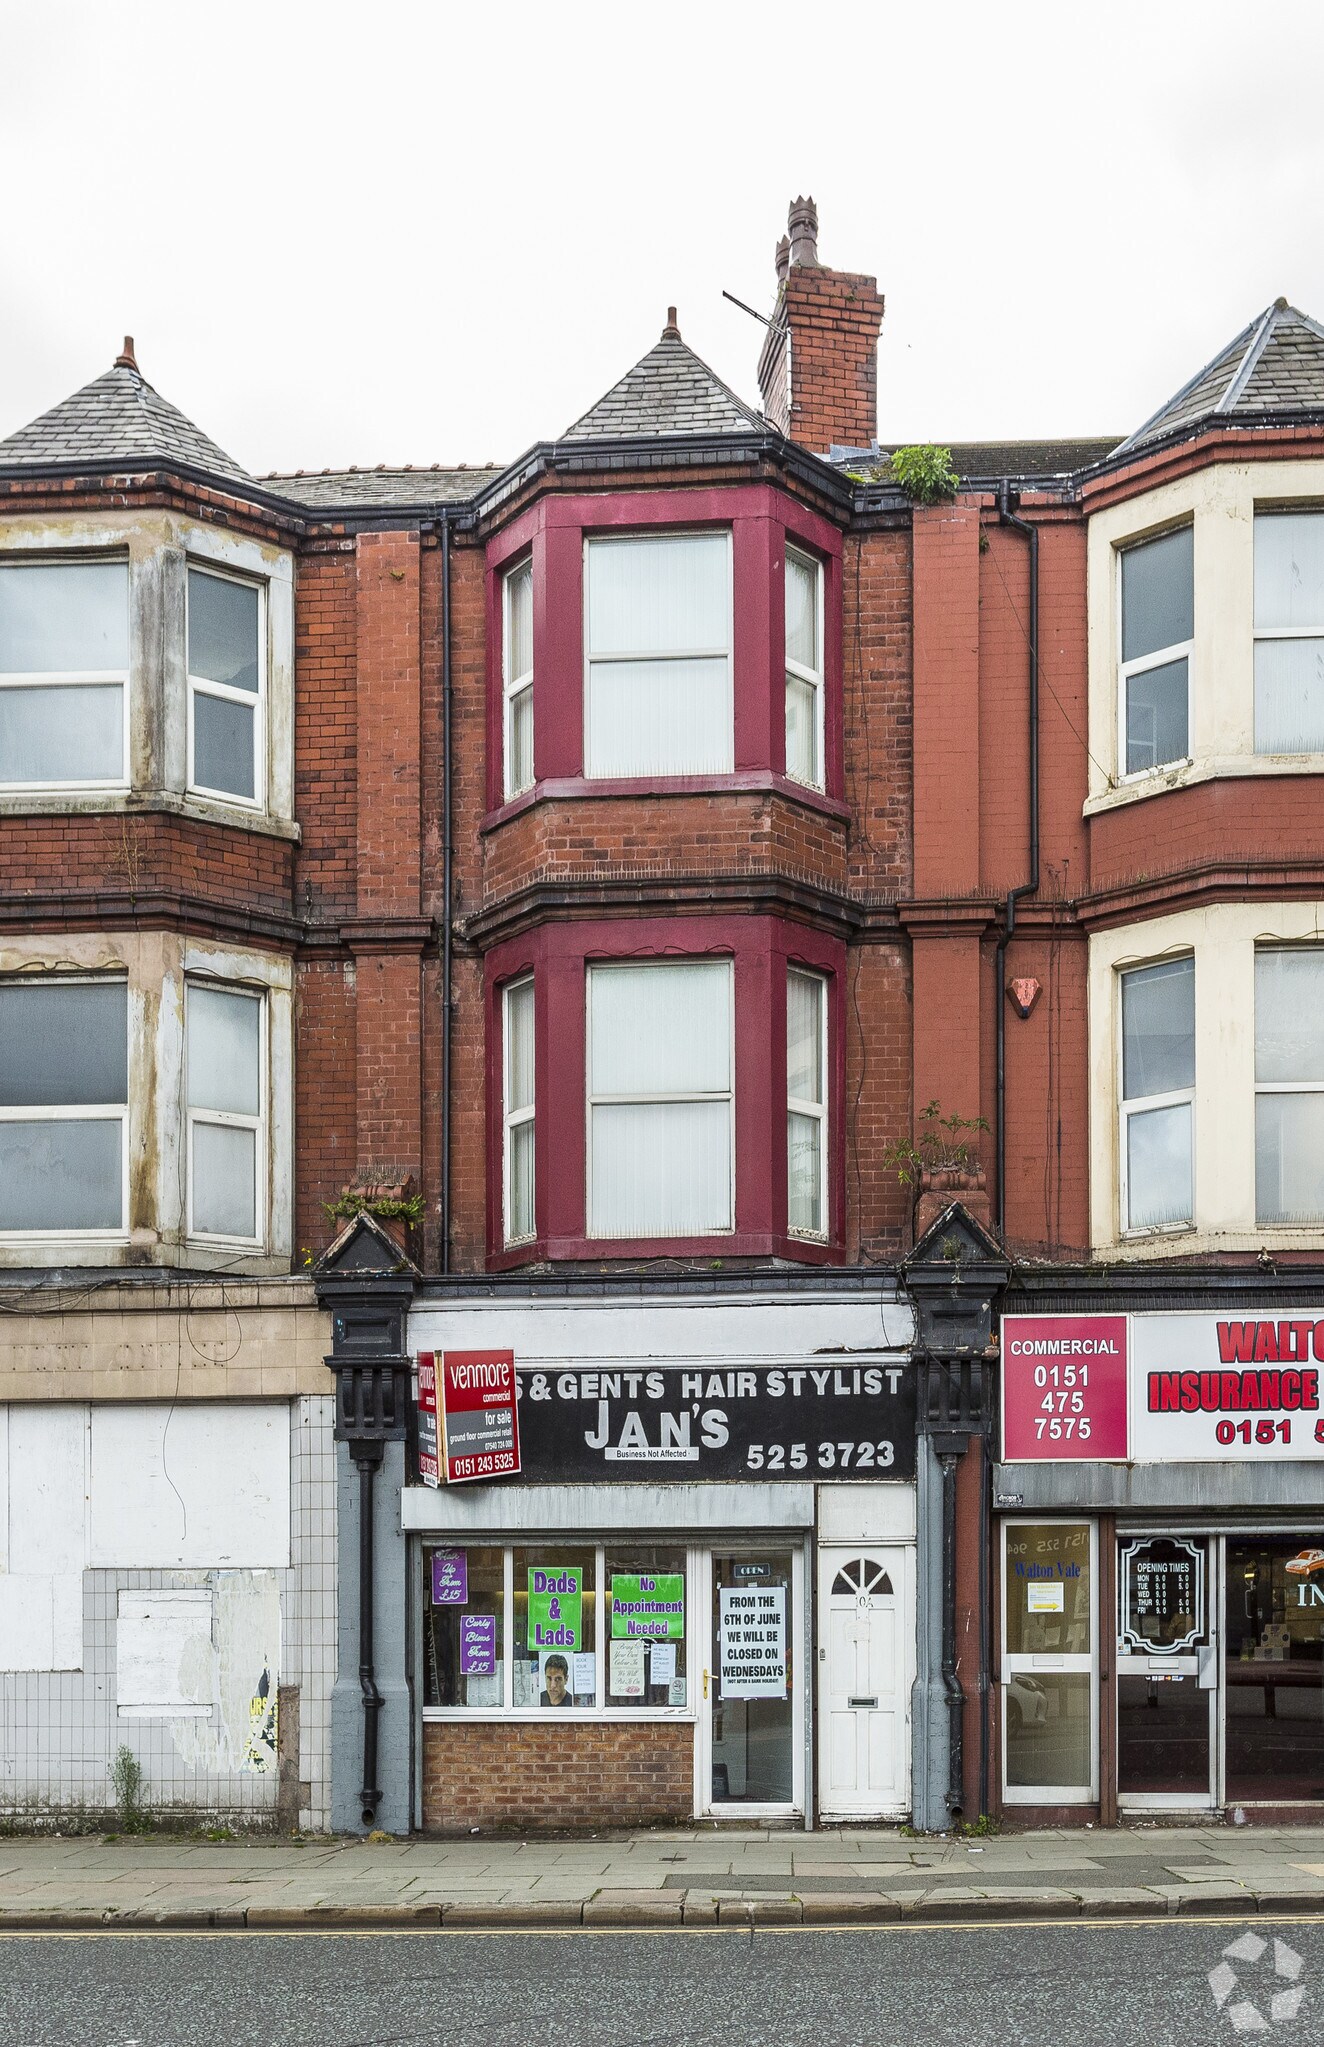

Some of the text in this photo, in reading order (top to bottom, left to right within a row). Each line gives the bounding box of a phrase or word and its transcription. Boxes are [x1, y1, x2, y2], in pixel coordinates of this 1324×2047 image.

[1010, 1339, 1119, 1356] COMMERCIAL
[450, 1362, 510, 1389] venmore
[1033, 1364, 1089, 1388] 0151
[681, 1372, 757, 1399] HAIR
[766, 1369, 903, 1397] STYLIST
[1148, 1368, 1320, 1413] INSURANCE
[483, 1390, 511, 1402] commercial
[1041, 1391, 1084, 1414] 475
[484, 1410, 512, 1426] for sale
[584, 1399, 730, 1449] JAN'S
[1034, 1417, 1092, 1441] 7575
[1215, 1418, 1292, 1446] 0151
[449, 1432, 466, 1445] ground
[476, 1429, 502, 1440] commercial
[616, 1450, 687, 1459] Business Not Affected
[746, 1440, 895, 1470] 525 3723
[454, 1457, 475, 1476] 0151
[477, 1455, 493, 1473] 243
[494, 1452, 514, 1471] 5325
[442, 1563, 456, 1576] Up
[740, 1566, 764, 1575] OPEN
[1015, 1562, 1081, 1579] Walton Vale
[1137, 1563, 1190, 1572] OPENING TIMES
[534, 1571, 577, 1594] Dads
[640, 1577, 656, 1592] No
[1137, 1574, 1150, 1582] MON
[1137, 1582, 1149, 1590] TUE
[438, 1589, 462, 1601] £15
[1137, 1590, 1150, 1598] WED
[548, 1597, 562, 1620] &
[613, 1599, 683, 1616] Appointment
[729, 1596, 775, 1608] FROM THE
[1138, 1598, 1153, 1606] THUR
[1137, 1606, 1147, 1614] FRI
[465, 1617, 491, 1630] Curly
[724, 1613, 781, 1626] 6TH OF JUNE
[535, 1623, 576, 1647] Lads
[627, 1620, 669, 1635] Needed
[727, 1631, 778, 1643] WE WILL BE
[467, 1645, 491, 1658] From
[727, 1648, 778, 1660] CLOSED ON
[467, 1661, 490, 1673] £15
[722, 1665, 784, 1677] WEDNESDAYS
